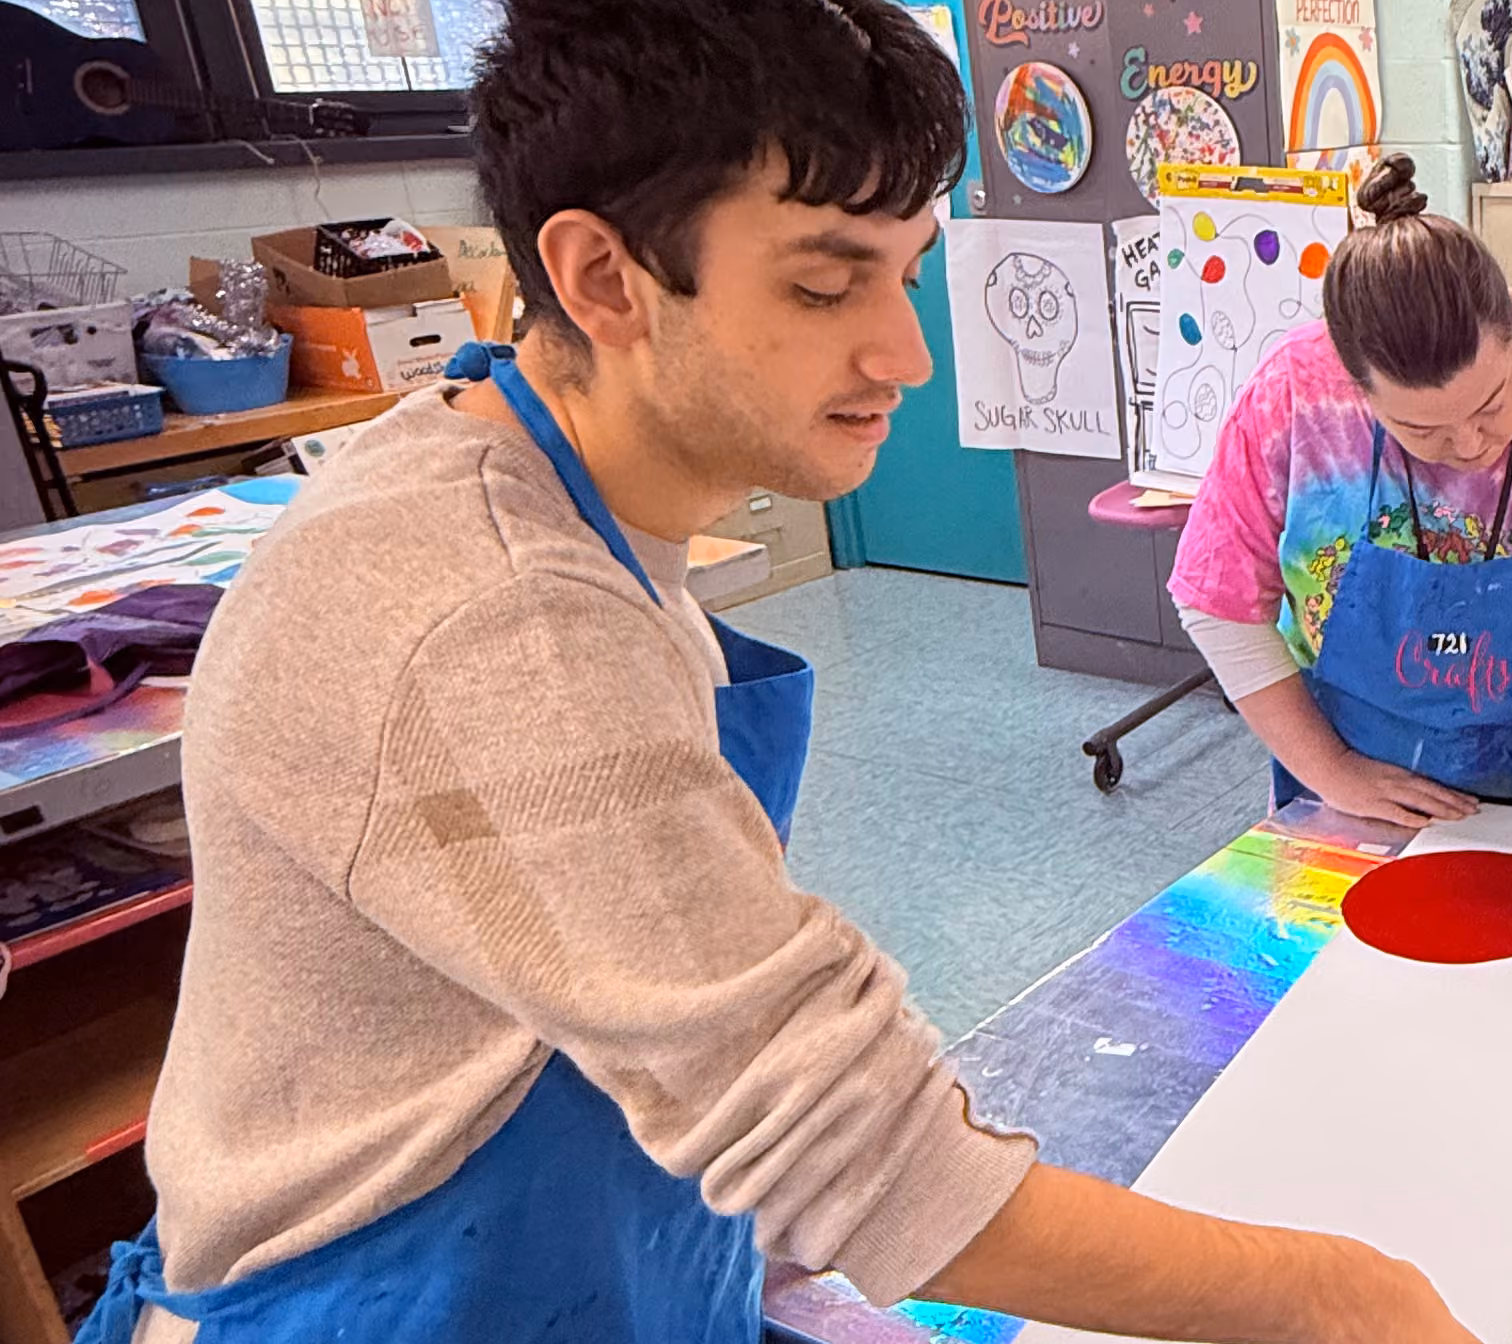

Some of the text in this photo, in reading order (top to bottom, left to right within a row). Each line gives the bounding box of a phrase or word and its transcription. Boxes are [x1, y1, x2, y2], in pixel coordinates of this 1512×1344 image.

[1120, 46, 1258, 100] Energy
[973, 400, 1112, 436] SUGAR SKULL
[1431, 632, 1468, 656] 721
[1395, 629, 1512, 716] Crafts
